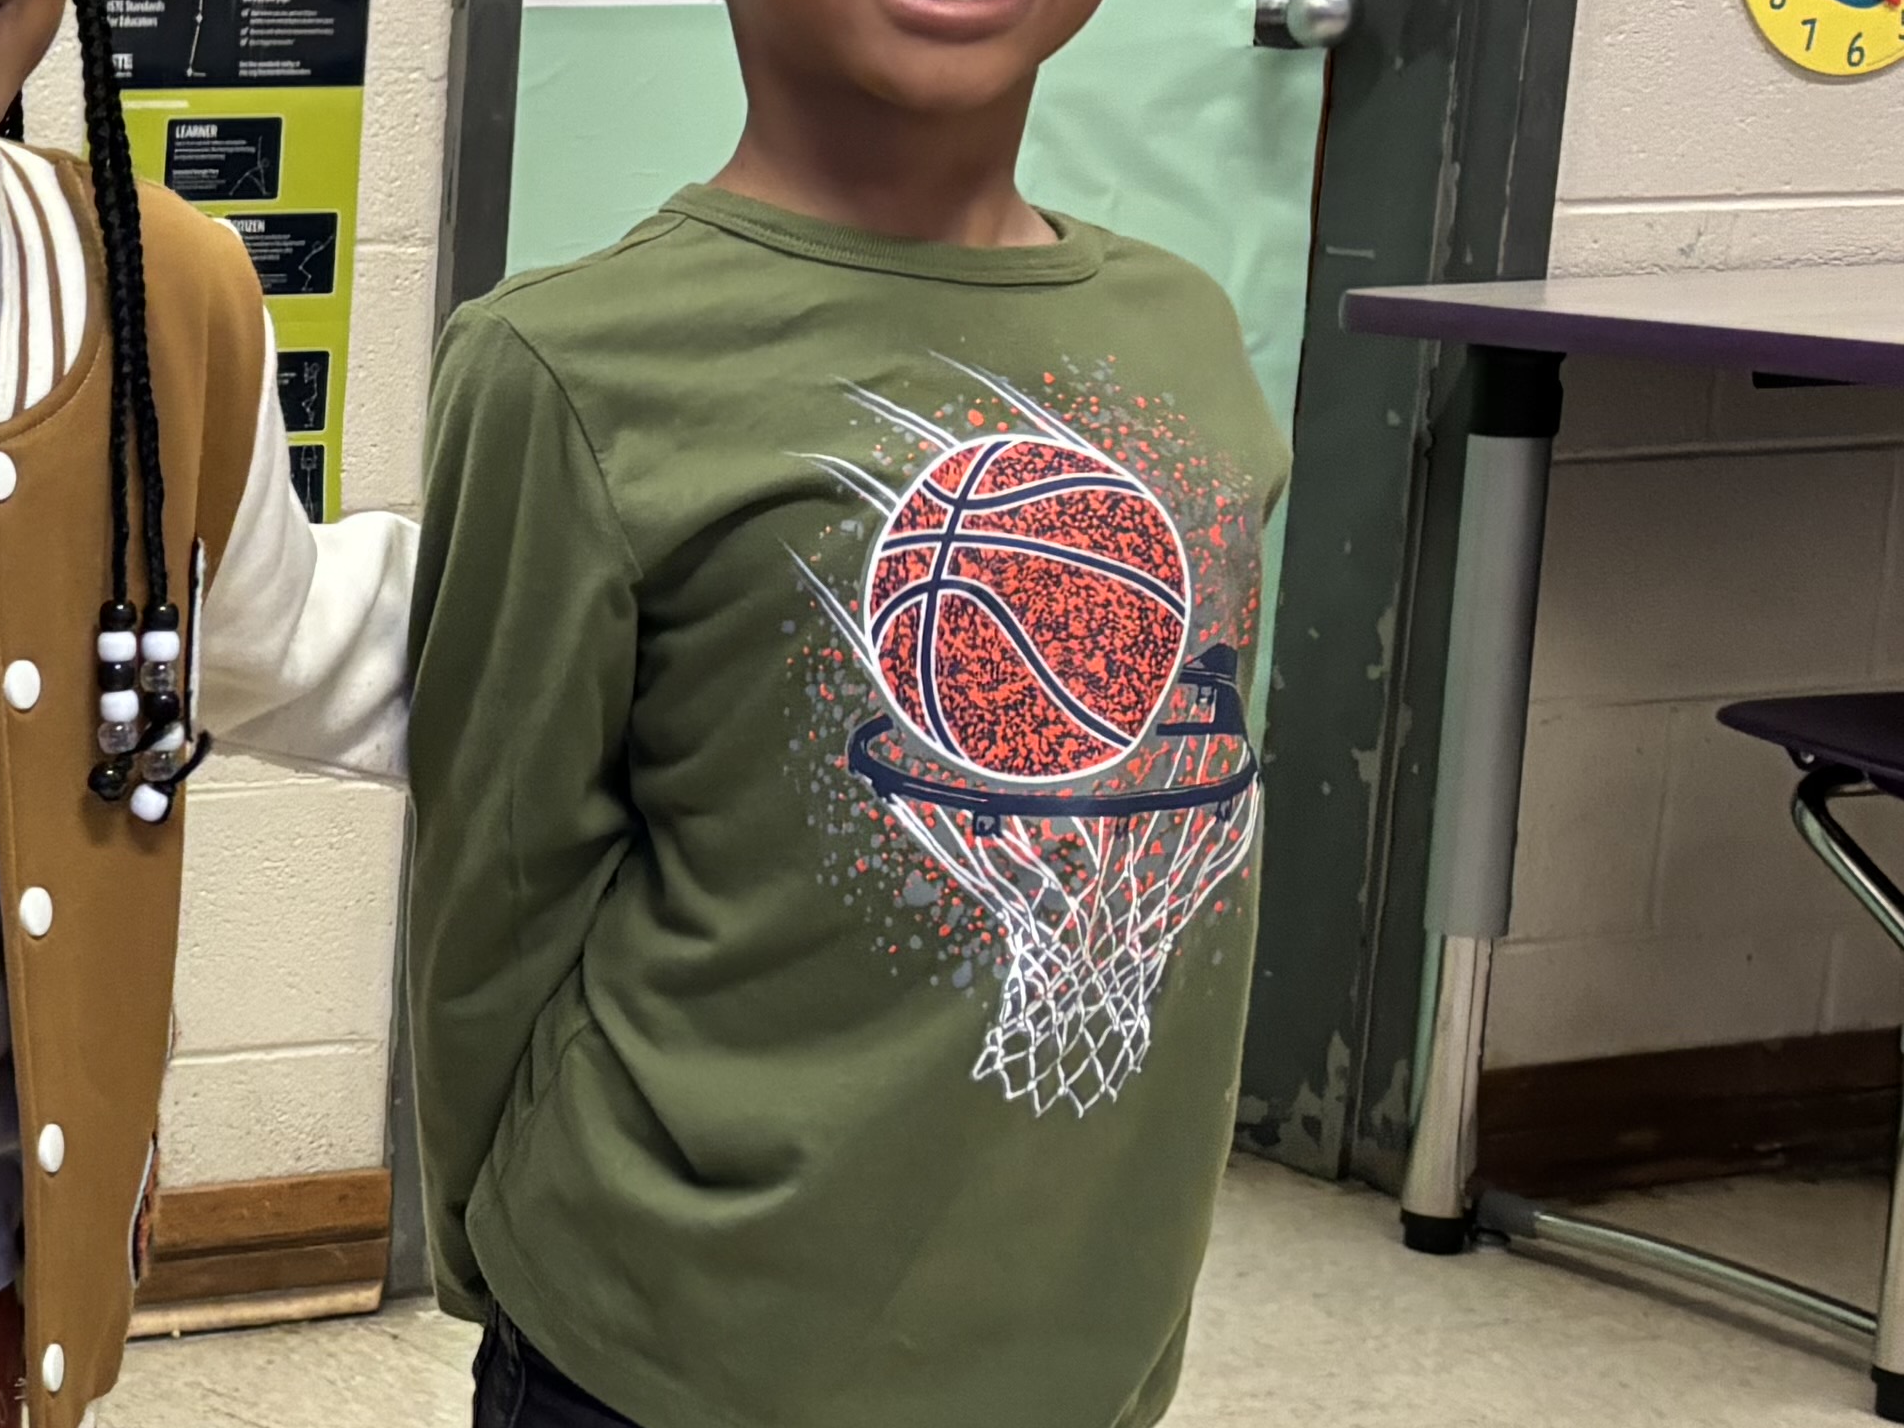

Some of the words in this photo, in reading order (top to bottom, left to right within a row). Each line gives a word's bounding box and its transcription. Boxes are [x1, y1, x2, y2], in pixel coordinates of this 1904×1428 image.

[1801, 18, 1817, 51] 7
[1847, 32, 1865, 67] 6
[175, 124, 218, 139] LEARNER
